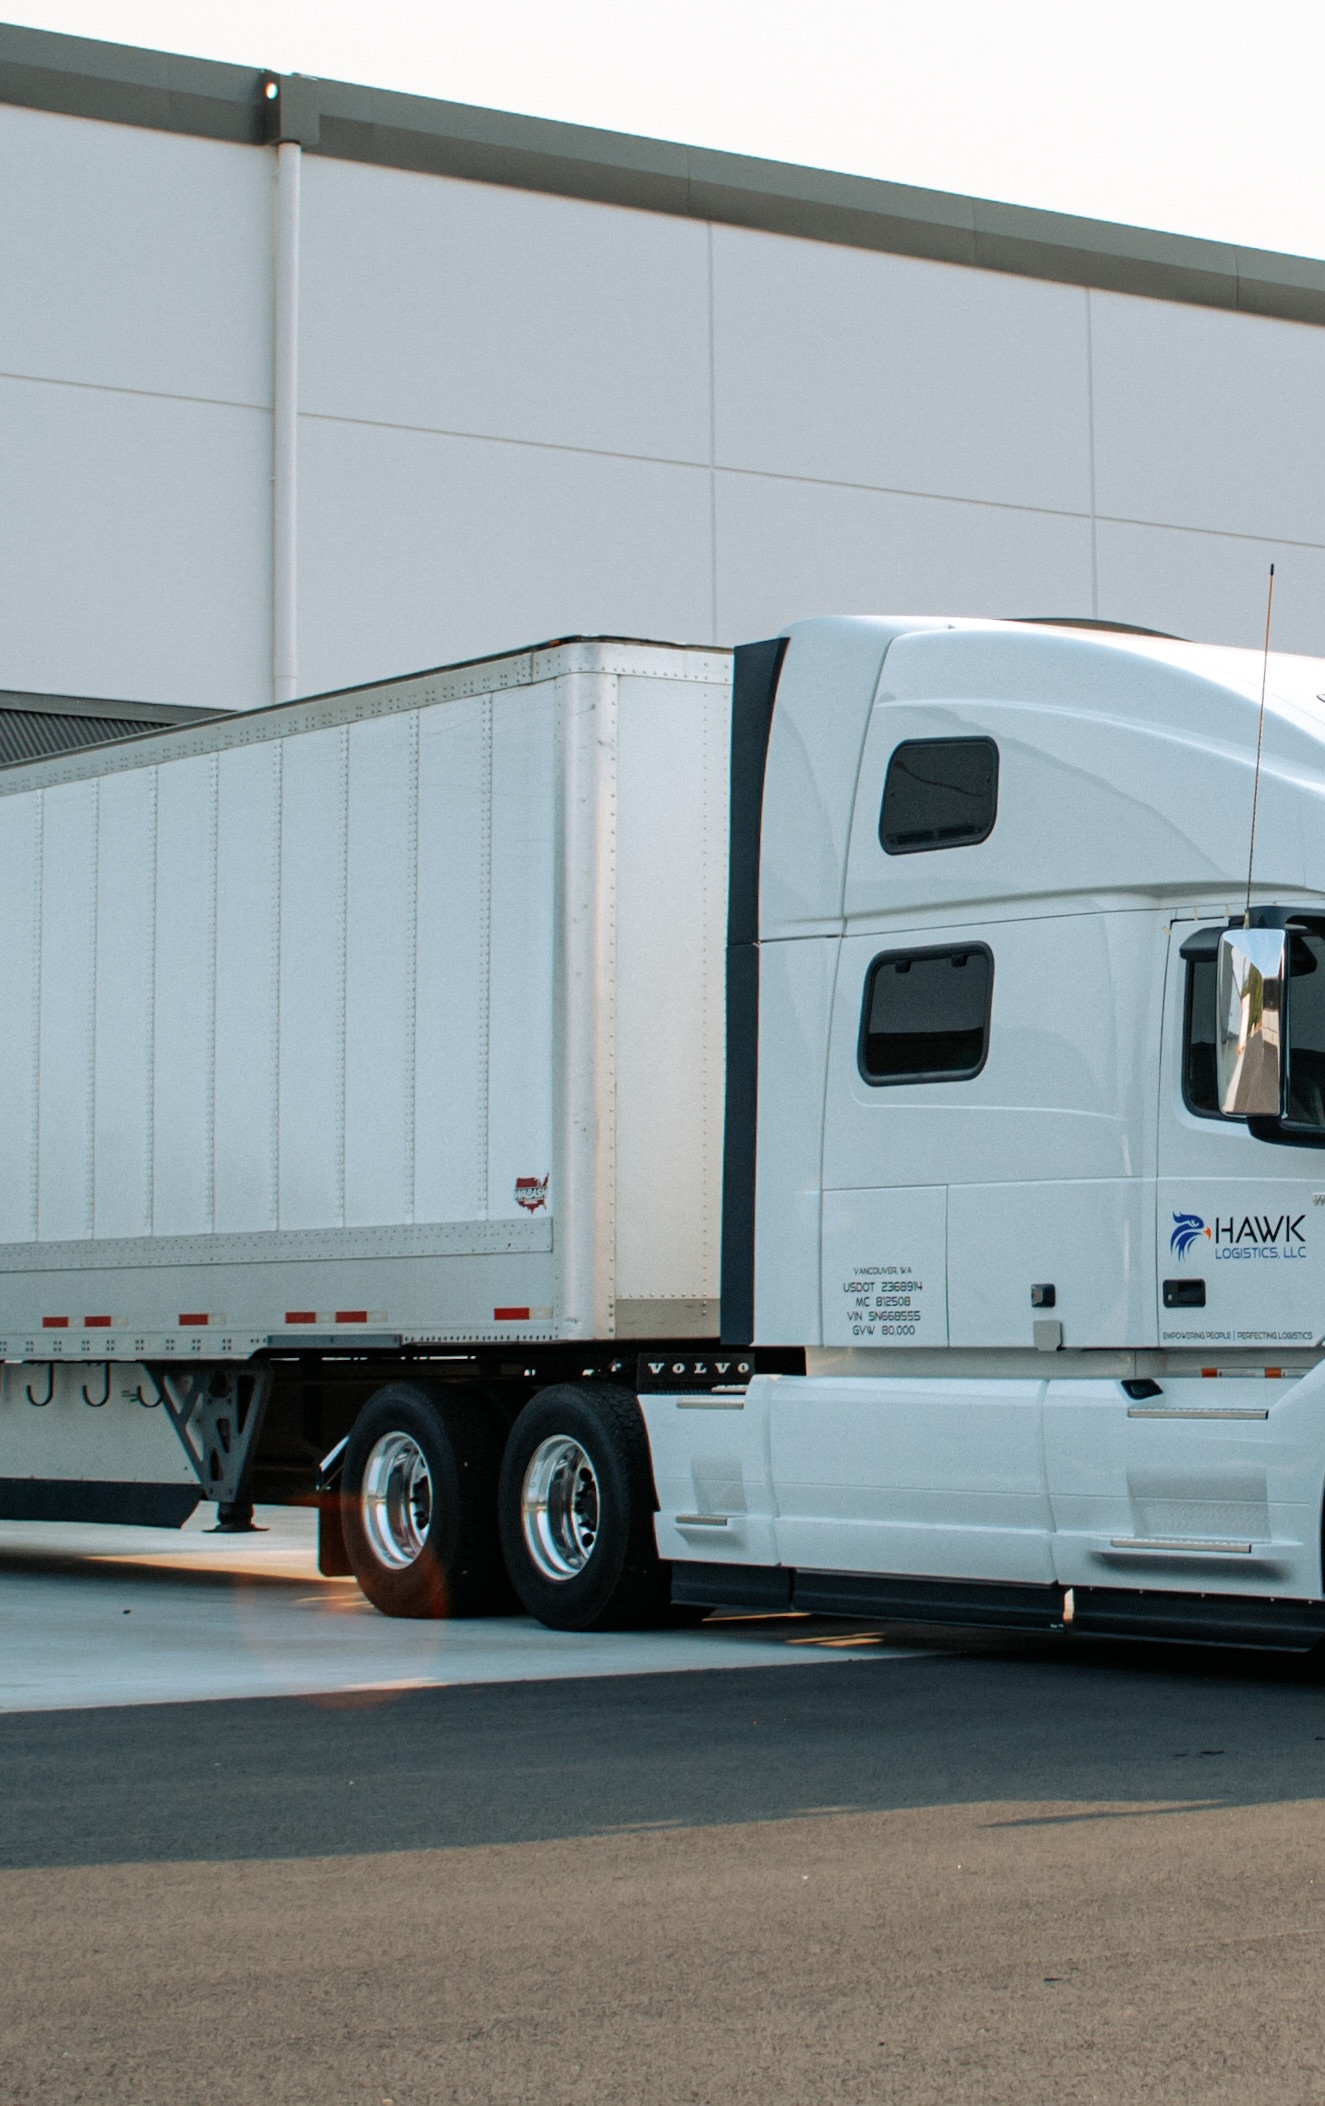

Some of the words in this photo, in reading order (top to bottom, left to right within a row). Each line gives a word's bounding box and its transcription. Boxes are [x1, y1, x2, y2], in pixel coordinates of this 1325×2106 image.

[1215, 1214, 1307, 1244] HAWK
[1215, 1247, 1281, 1260] LOGISTICS,
[1283, 1246, 1307, 1258] LLC
[900, 1266, 912, 1275] WA
[843, 1282, 875, 1293] USDOT
[856, 1297, 870, 1307] MC
[847, 1311, 863, 1321] VIN
[852, 1325, 876, 1336] GVW
[881, 1325, 916, 1337] 80,000
[1206, 1331, 1231, 1340] PEOPLE
[1237, 1331, 1277, 1340] PERFECTING
[1278, 1331, 1313, 1340] LOGISTICS
[647, 1362, 750, 1374] VOLVO
